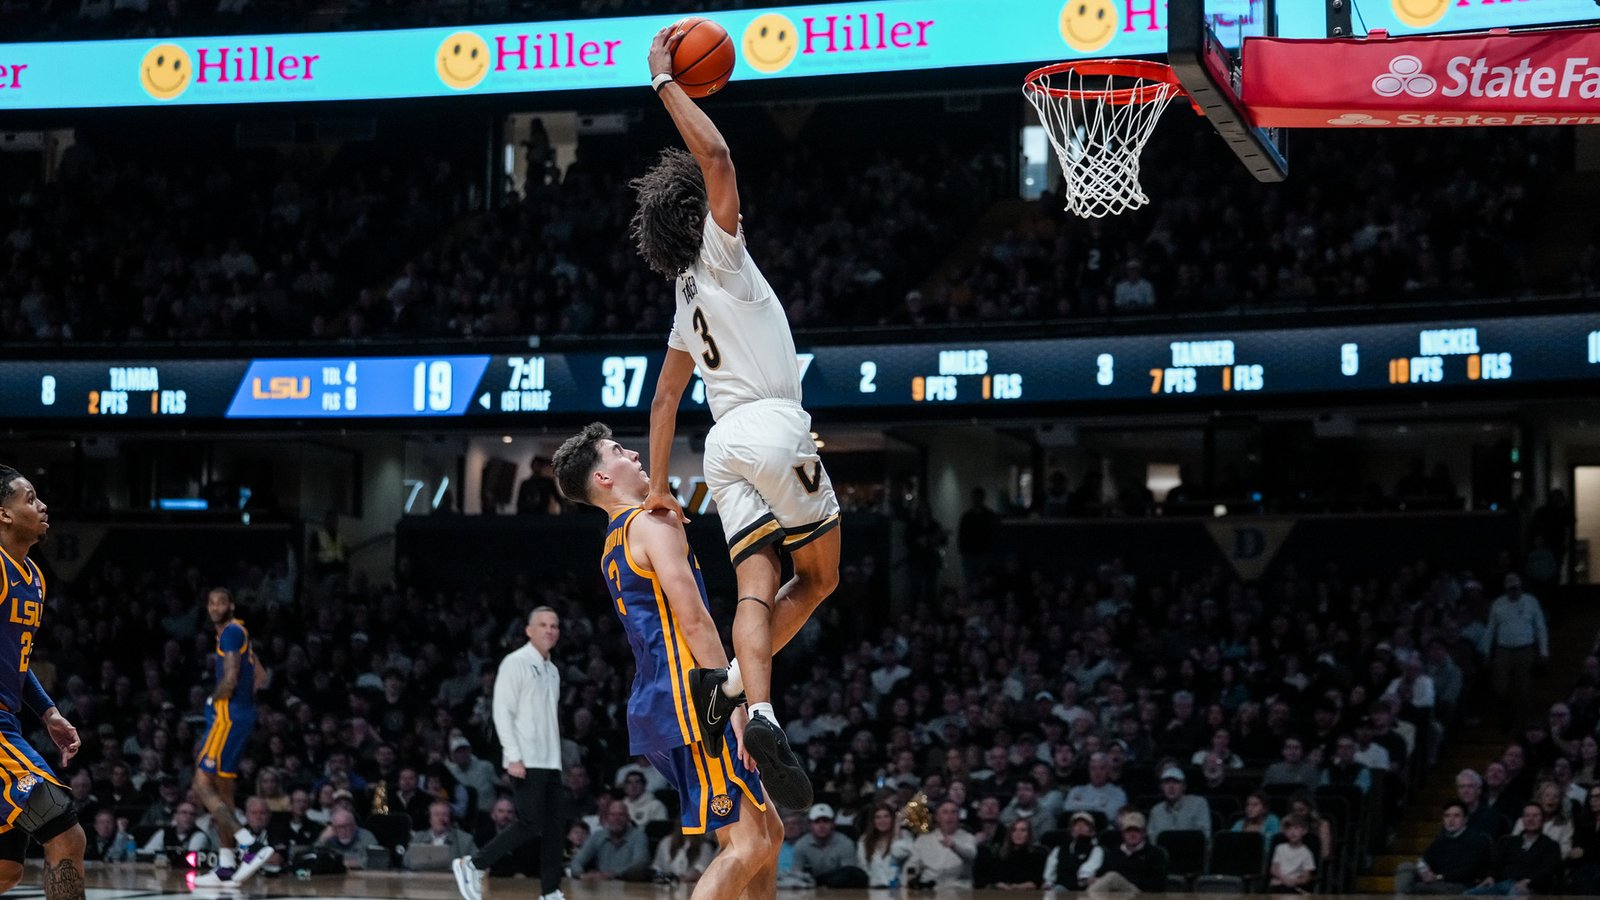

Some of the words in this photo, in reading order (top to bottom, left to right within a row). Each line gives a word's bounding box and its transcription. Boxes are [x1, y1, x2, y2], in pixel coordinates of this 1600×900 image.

[1122, 0, 1168, 33] H
[800, 12, 935, 54] Hiller
[195, 46, 320, 83] Hiller
[494, 32, 622, 72] Hiller
[1397, 114, 1507, 125] State
[1088, 249, 1101, 270] 2
[692, 305, 722, 371] 3
[1170, 340, 1235, 367] TANNER
[1420, 328, 1480, 356] NICKEL
[345, 361, 357, 385] 4
[507, 356, 545, 390] 7:11
[939, 350, 988, 375] MILES
[1096, 353, 1114, 386] 3
[1341, 343, 1359, 376] 5
[1389, 358, 1409, 384] 10
[1410, 356, 1443, 383] PTS
[1481, 352, 1512, 379] FLS
[41, 375, 56, 405] 8
[109, 367, 159, 391] TAMBA
[252, 376, 311, 400] LSU
[413, 360, 453, 412] 19
[601, 356, 648, 408] 37
[860, 361, 877, 393] 2
[925, 376, 957, 401] PTS
[982, 375, 991, 400] 1
[993, 373, 1022, 399] FLS
[1150, 368, 1163, 394] 7
[1164, 367, 1197, 393] PTS
[1222, 366, 1231, 391] 1
[1234, 364, 1264, 391] FLS
[88, 391, 99, 414] 2
[100, 391, 128, 414] PTS
[151, 392, 159, 414] 1
[161, 390, 187, 414] FLS
[322, 392, 341, 411] FLS
[501, 391, 520, 411] 1ST
[521, 390, 551, 411] HALF
[792, 460, 822, 495] V
[1232, 527, 1265, 559] D
